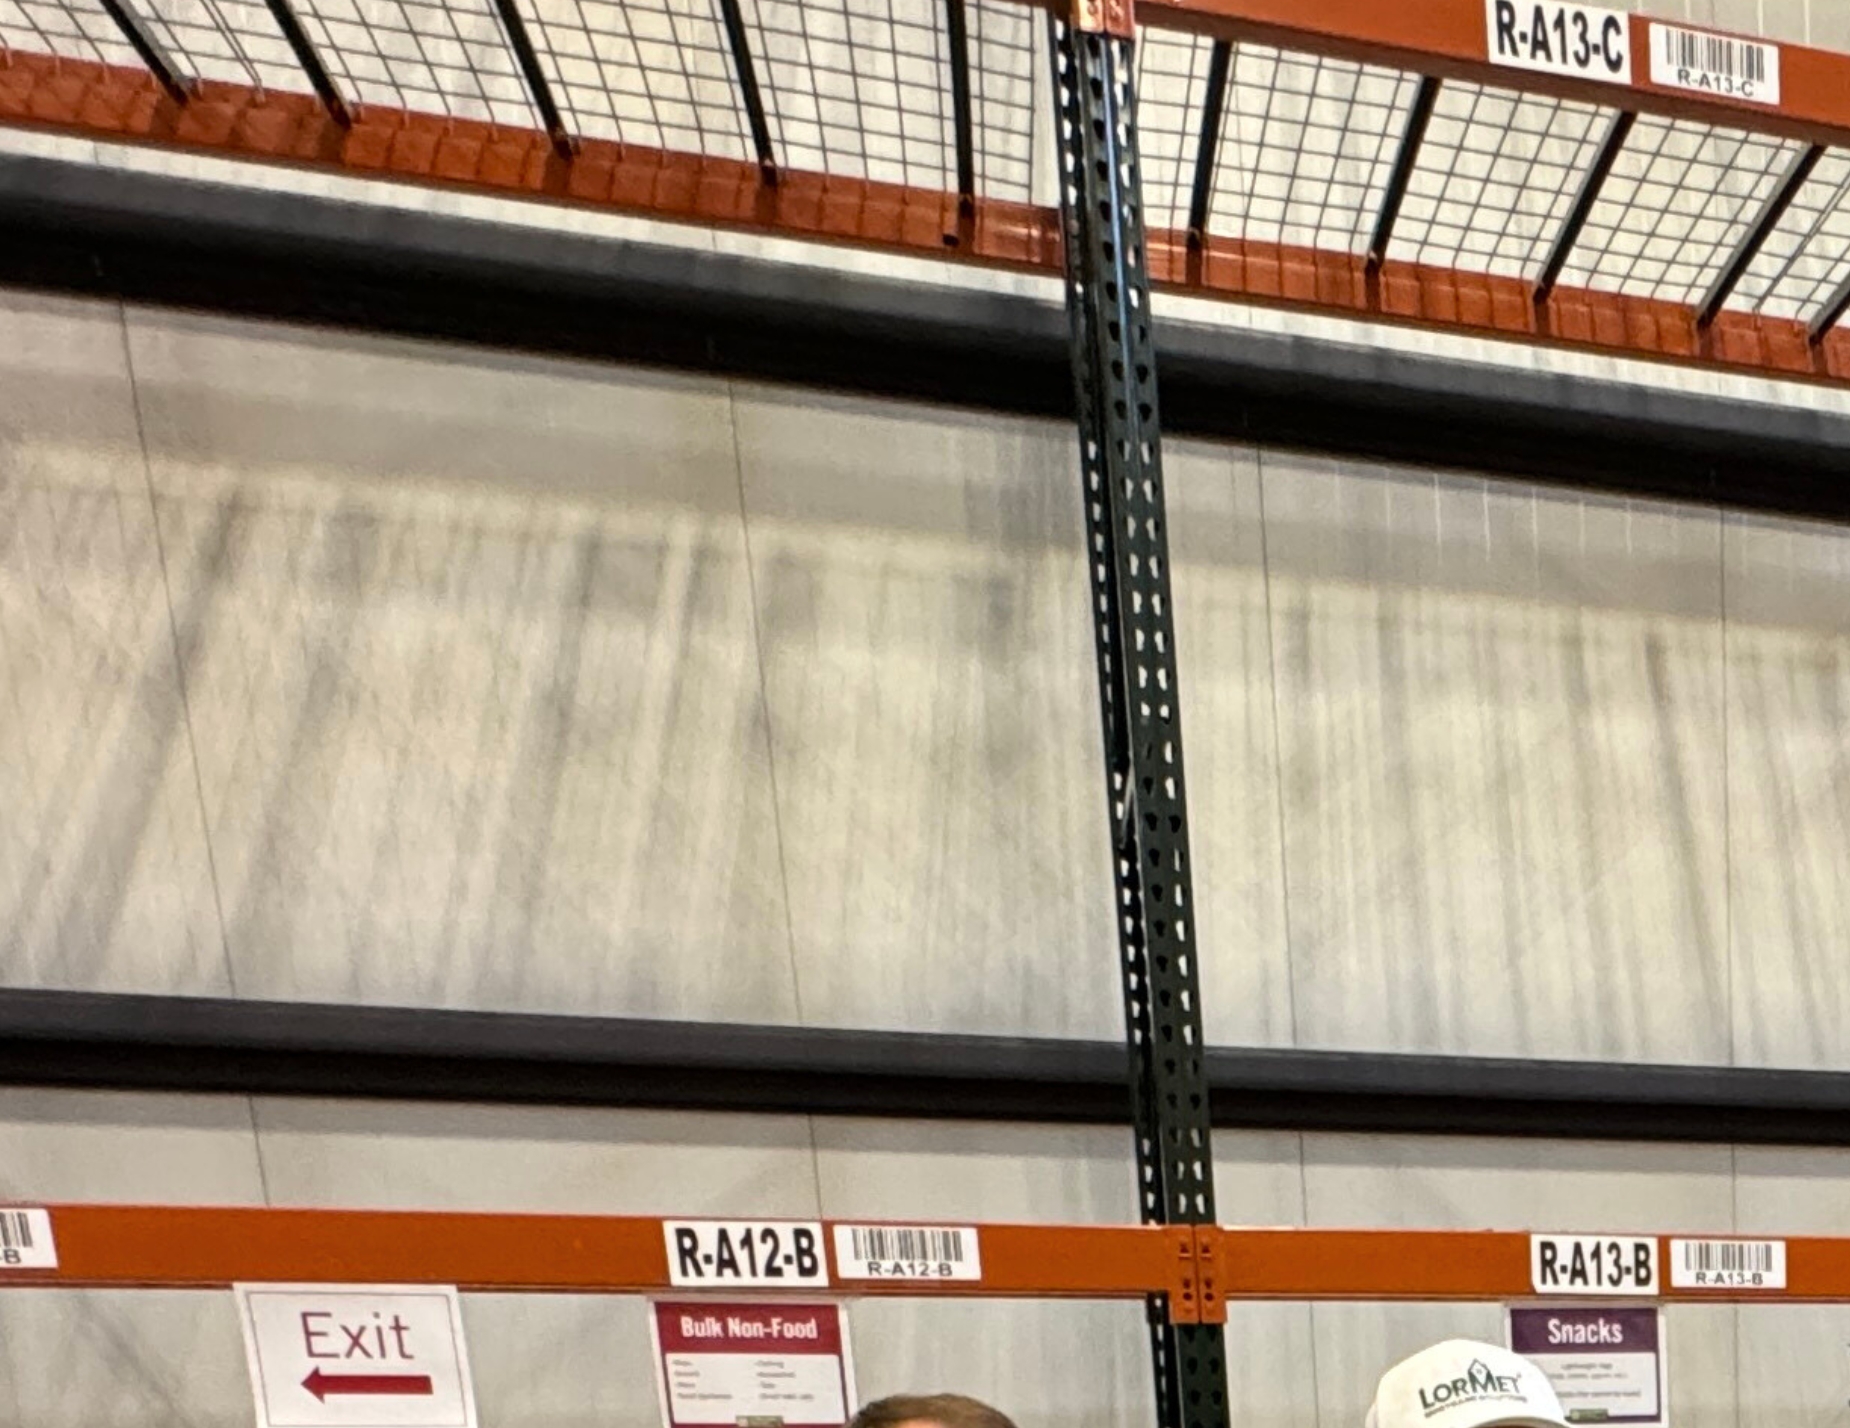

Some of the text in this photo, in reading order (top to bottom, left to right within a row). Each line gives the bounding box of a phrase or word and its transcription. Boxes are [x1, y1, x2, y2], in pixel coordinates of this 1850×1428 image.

[1495, 0, 1624, 73] R-A13-C
[1677, 68, 1754, 97] R-A13-C
[674, 1227, 819, 1278] R-A12-B
[1539, 1241, 1653, 1288] R-A13-B
[867, 1260, 953, 1277] R-A12-B
[1695, 1272, 1764, 1286] R-A13-B
[301, 1312, 415, 1360] Exit
[680, 1316, 818, 1340] Bulk Non-Food
[1548, 1318, 1624, 1344] Snacks
